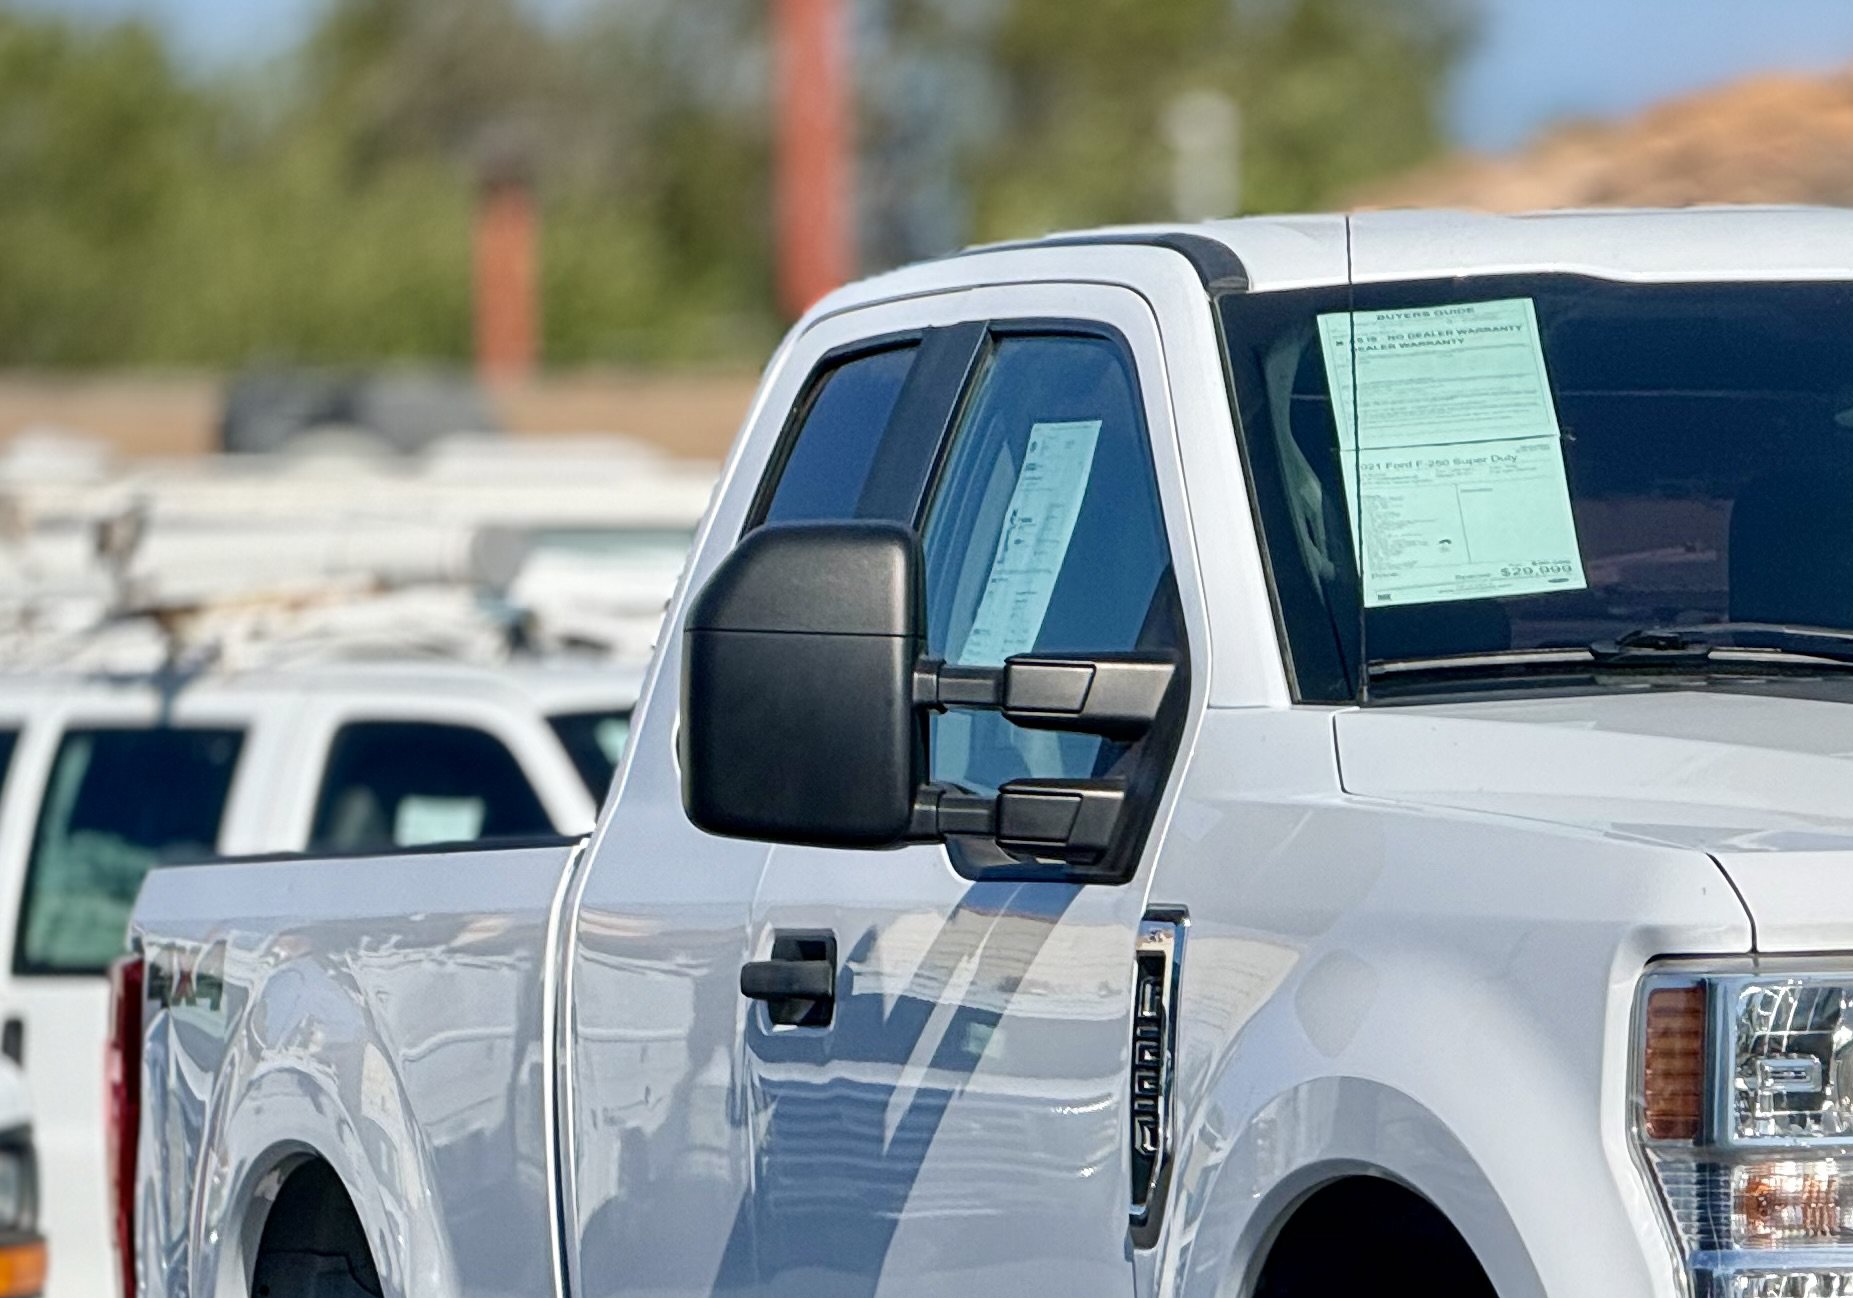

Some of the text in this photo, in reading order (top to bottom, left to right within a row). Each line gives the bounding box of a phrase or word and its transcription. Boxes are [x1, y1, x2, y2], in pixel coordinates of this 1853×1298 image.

[1376, 307, 1475, 321] BUYERS GUIDE
[1407, 329, 1454, 340] DEALER
[1456, 325, 1522, 335] WARRANTY
[1399, 338, 1464, 349] WARRANTY
[1386, 461, 1412, 469] Ford
[1453, 457, 1487, 466] Super
[1490, 454, 1517, 464] Duty
